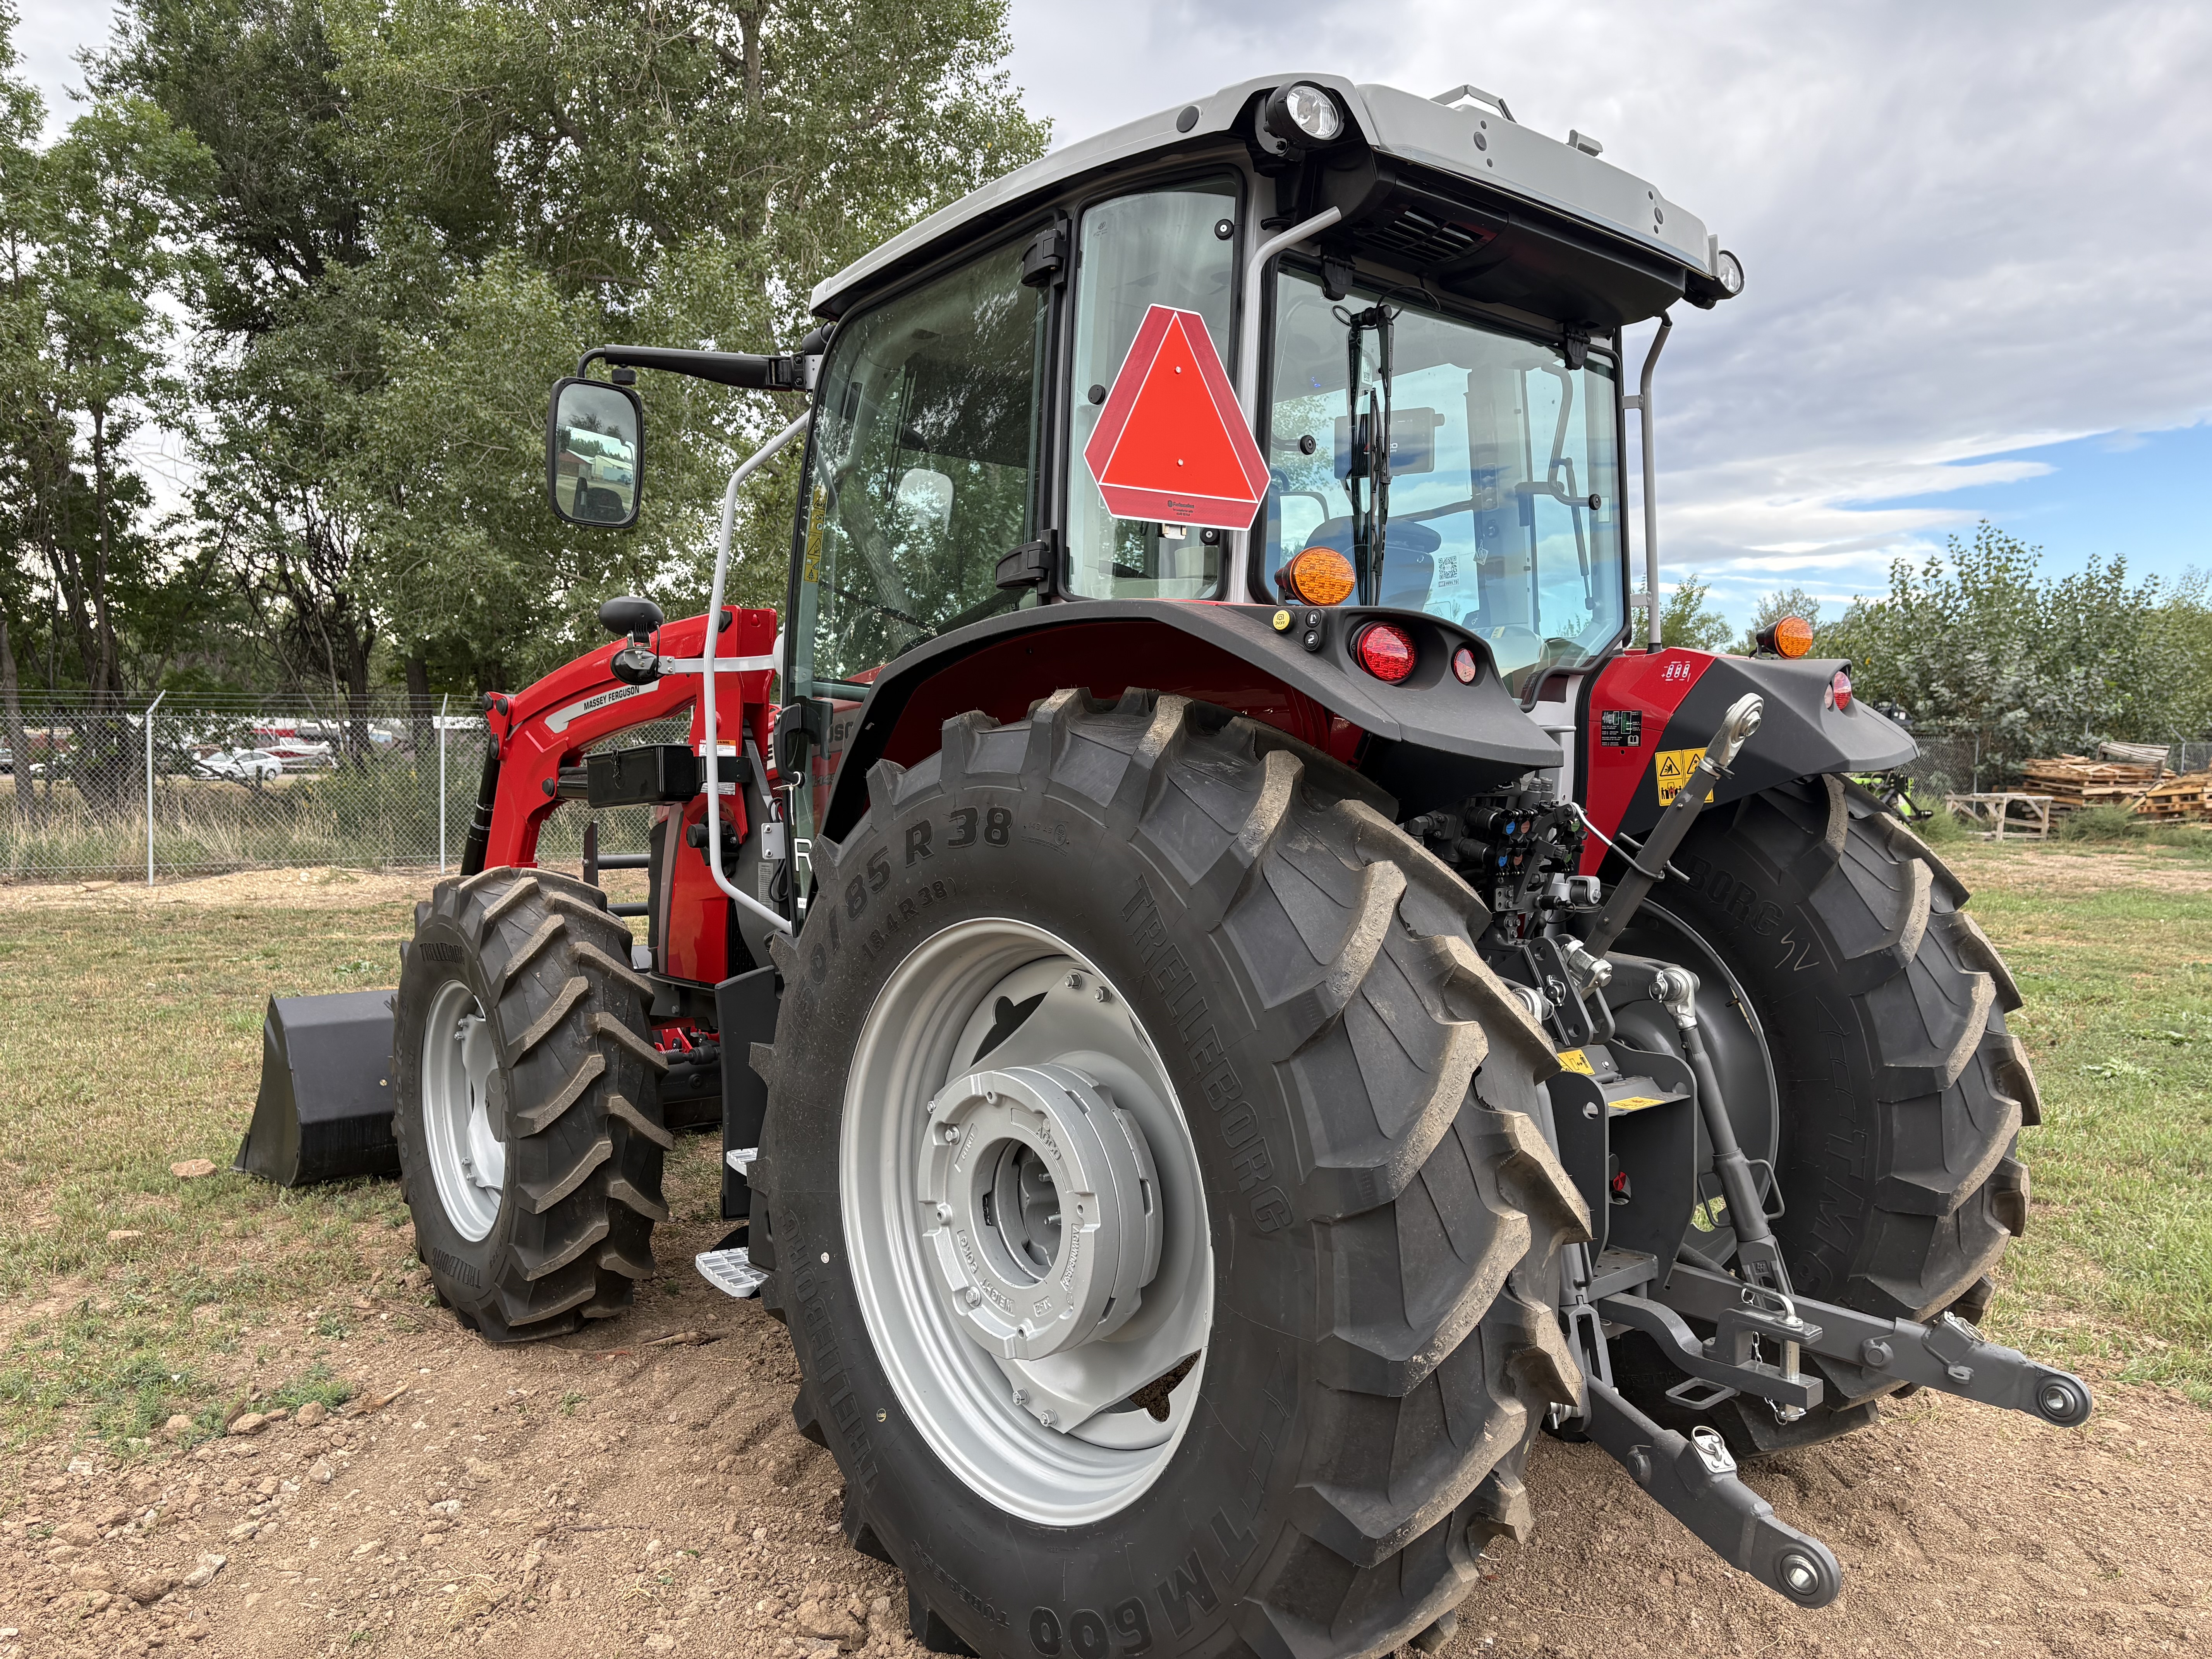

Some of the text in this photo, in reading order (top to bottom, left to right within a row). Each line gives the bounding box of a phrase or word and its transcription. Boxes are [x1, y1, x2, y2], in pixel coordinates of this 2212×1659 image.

[584, 685, 639, 711] MASSEY FERGUSON
[794, 838, 812, 871] R
[905, 818, 933, 867] R
[947, 805, 1013, 848] 38
[419, 942, 464, 964] TRELLEBORG
[862, 914, 899, 961] 18.4
[900, 897, 919, 923] R
[395, 1041, 405, 1066] R
[1120, 871, 1293, 1234] TRELLEBORG
[1036, 1126, 1061, 1160] AGCO
[1791, 1130, 1868, 1293] TM6
[433, 1247, 481, 1290] TRELLEBORG
[961, 1237, 1015, 1313] WEIGHT 50KG
[781, 1209, 878, 1496] TRELLEBORG
[910, 1540, 1010, 1628] TUBELESS
